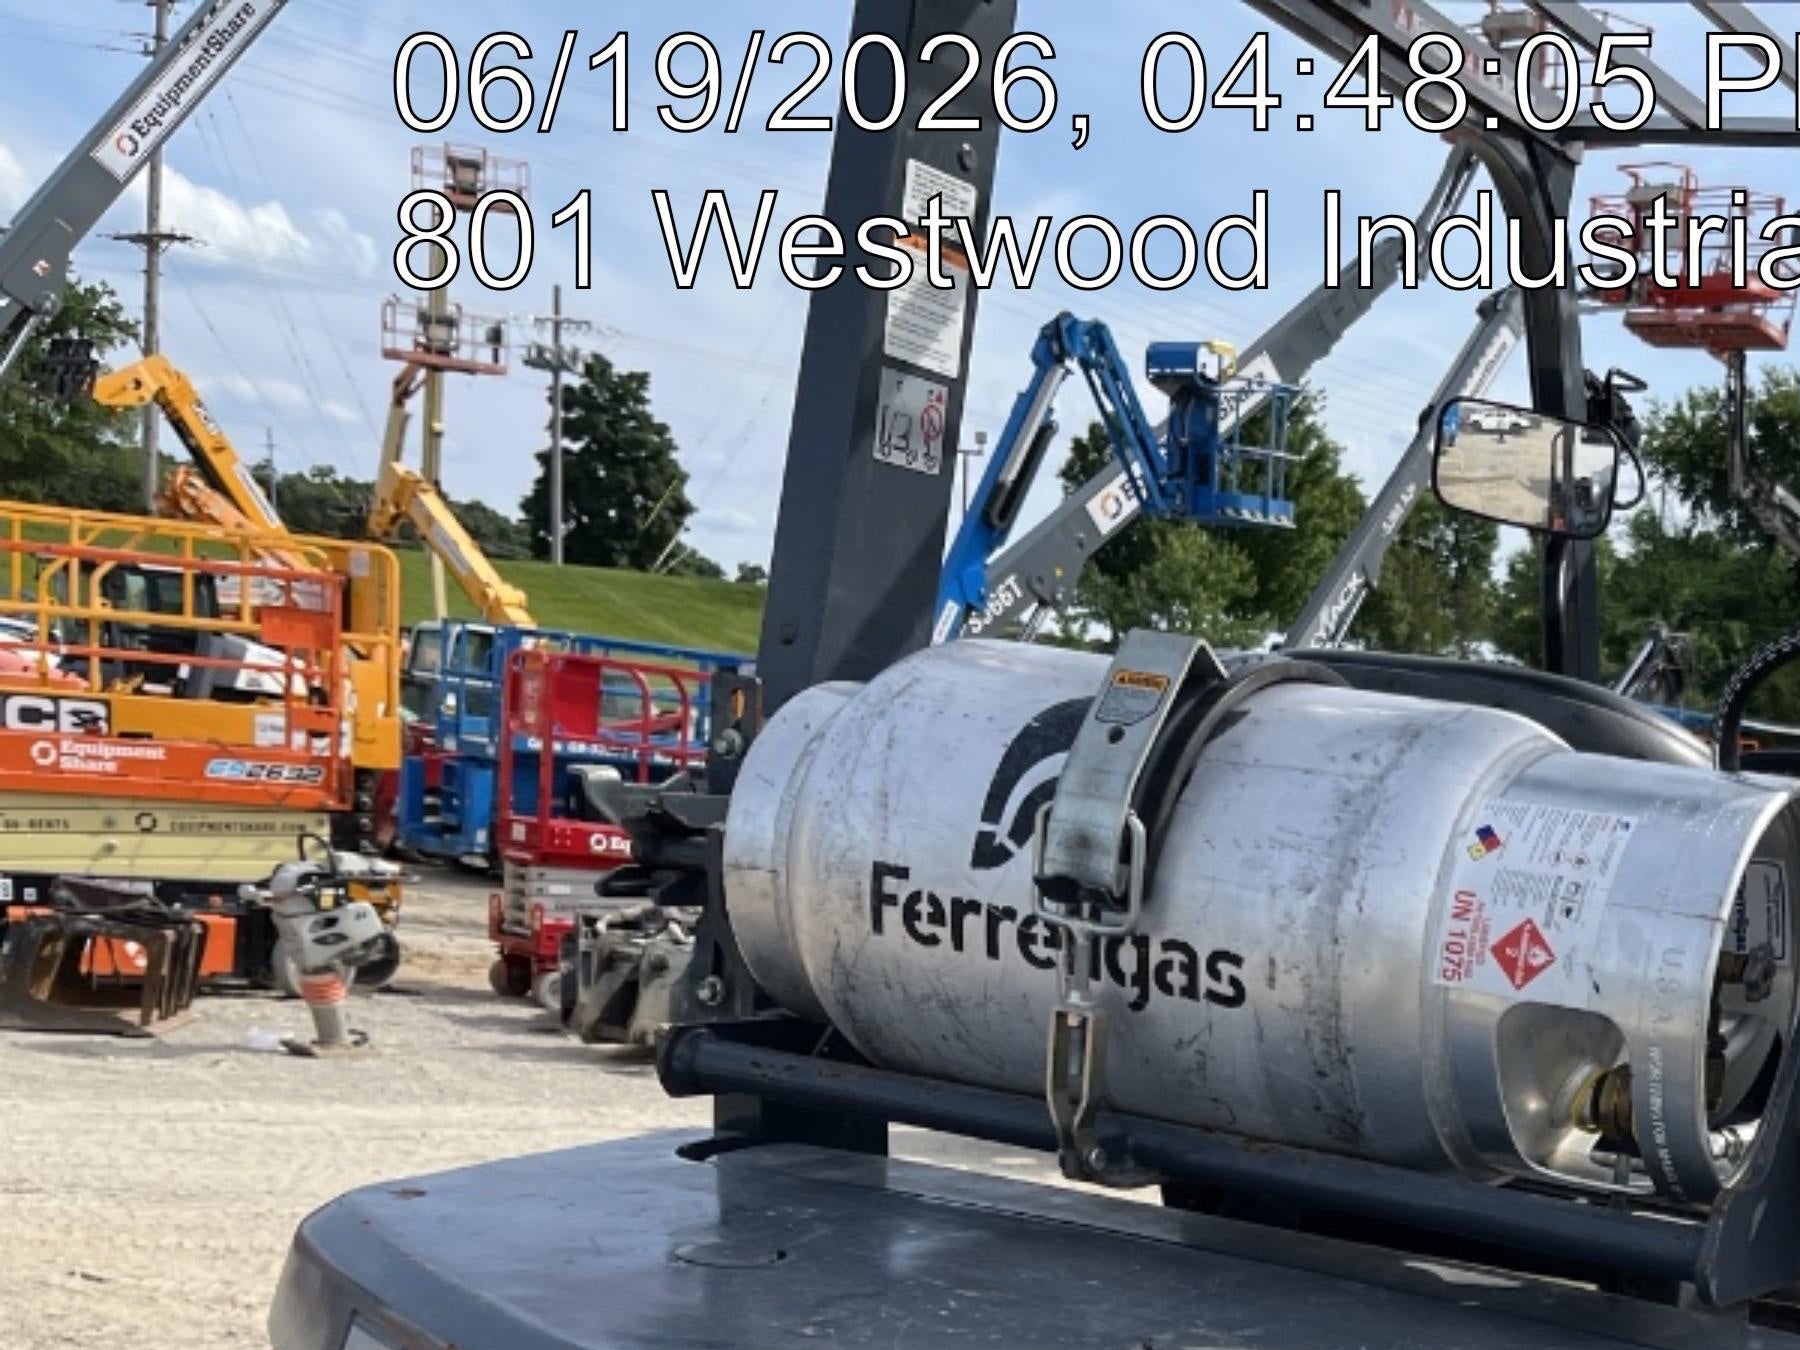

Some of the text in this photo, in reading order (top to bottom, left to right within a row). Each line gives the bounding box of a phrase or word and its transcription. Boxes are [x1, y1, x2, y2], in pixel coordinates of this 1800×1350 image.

[130, 2, 256, 139] EquipmentShare
[59, 740, 167, 761] Equipment
[59, 757, 119, 773] Share
[1451, 889, 1477, 922] UN
[870, 861, 1247, 1013] Ferregas
[1442, 929, 1467, 983] 1075
